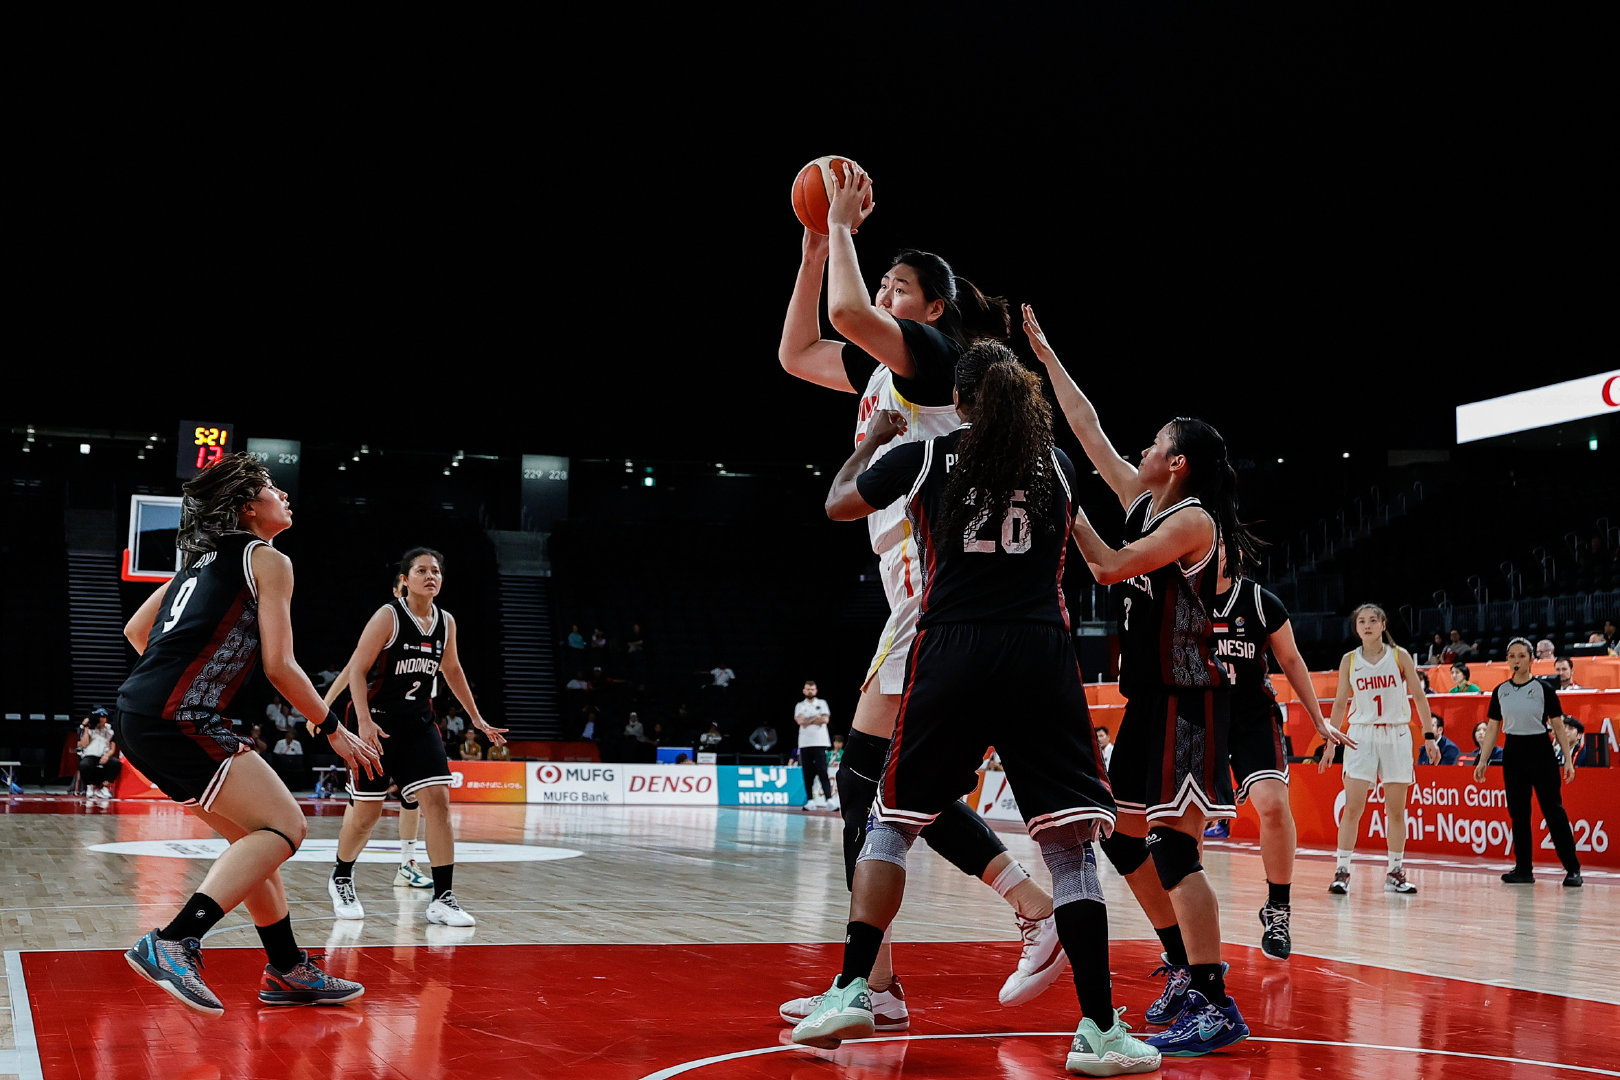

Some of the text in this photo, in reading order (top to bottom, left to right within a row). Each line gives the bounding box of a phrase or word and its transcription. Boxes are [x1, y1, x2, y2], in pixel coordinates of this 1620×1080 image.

[194, 427, 227, 446] 5:21
[278, 453, 298, 464] 229
[523, 470, 543, 480] 229
[162, 576, 198, 634] 9
[1215, 639, 1256, 660] NESIA
[404, 680, 422, 701] 2
[1356, 674, 1398, 692] CHINA
[1373, 694, 1383, 717] 1
[566, 768, 615, 782] MUFG
[628, 775, 713, 793] DENSO
[738, 766, 788, 789] ニトリ
[543, 791, 609, 802] MUFG Bank
[738, 791, 788, 805] NITORI
[1410, 781, 1459, 807] Asian
[1464, 784, 1508, 808] Gam
[1367, 808, 1609, 856] Aihi-Nagoy 226
